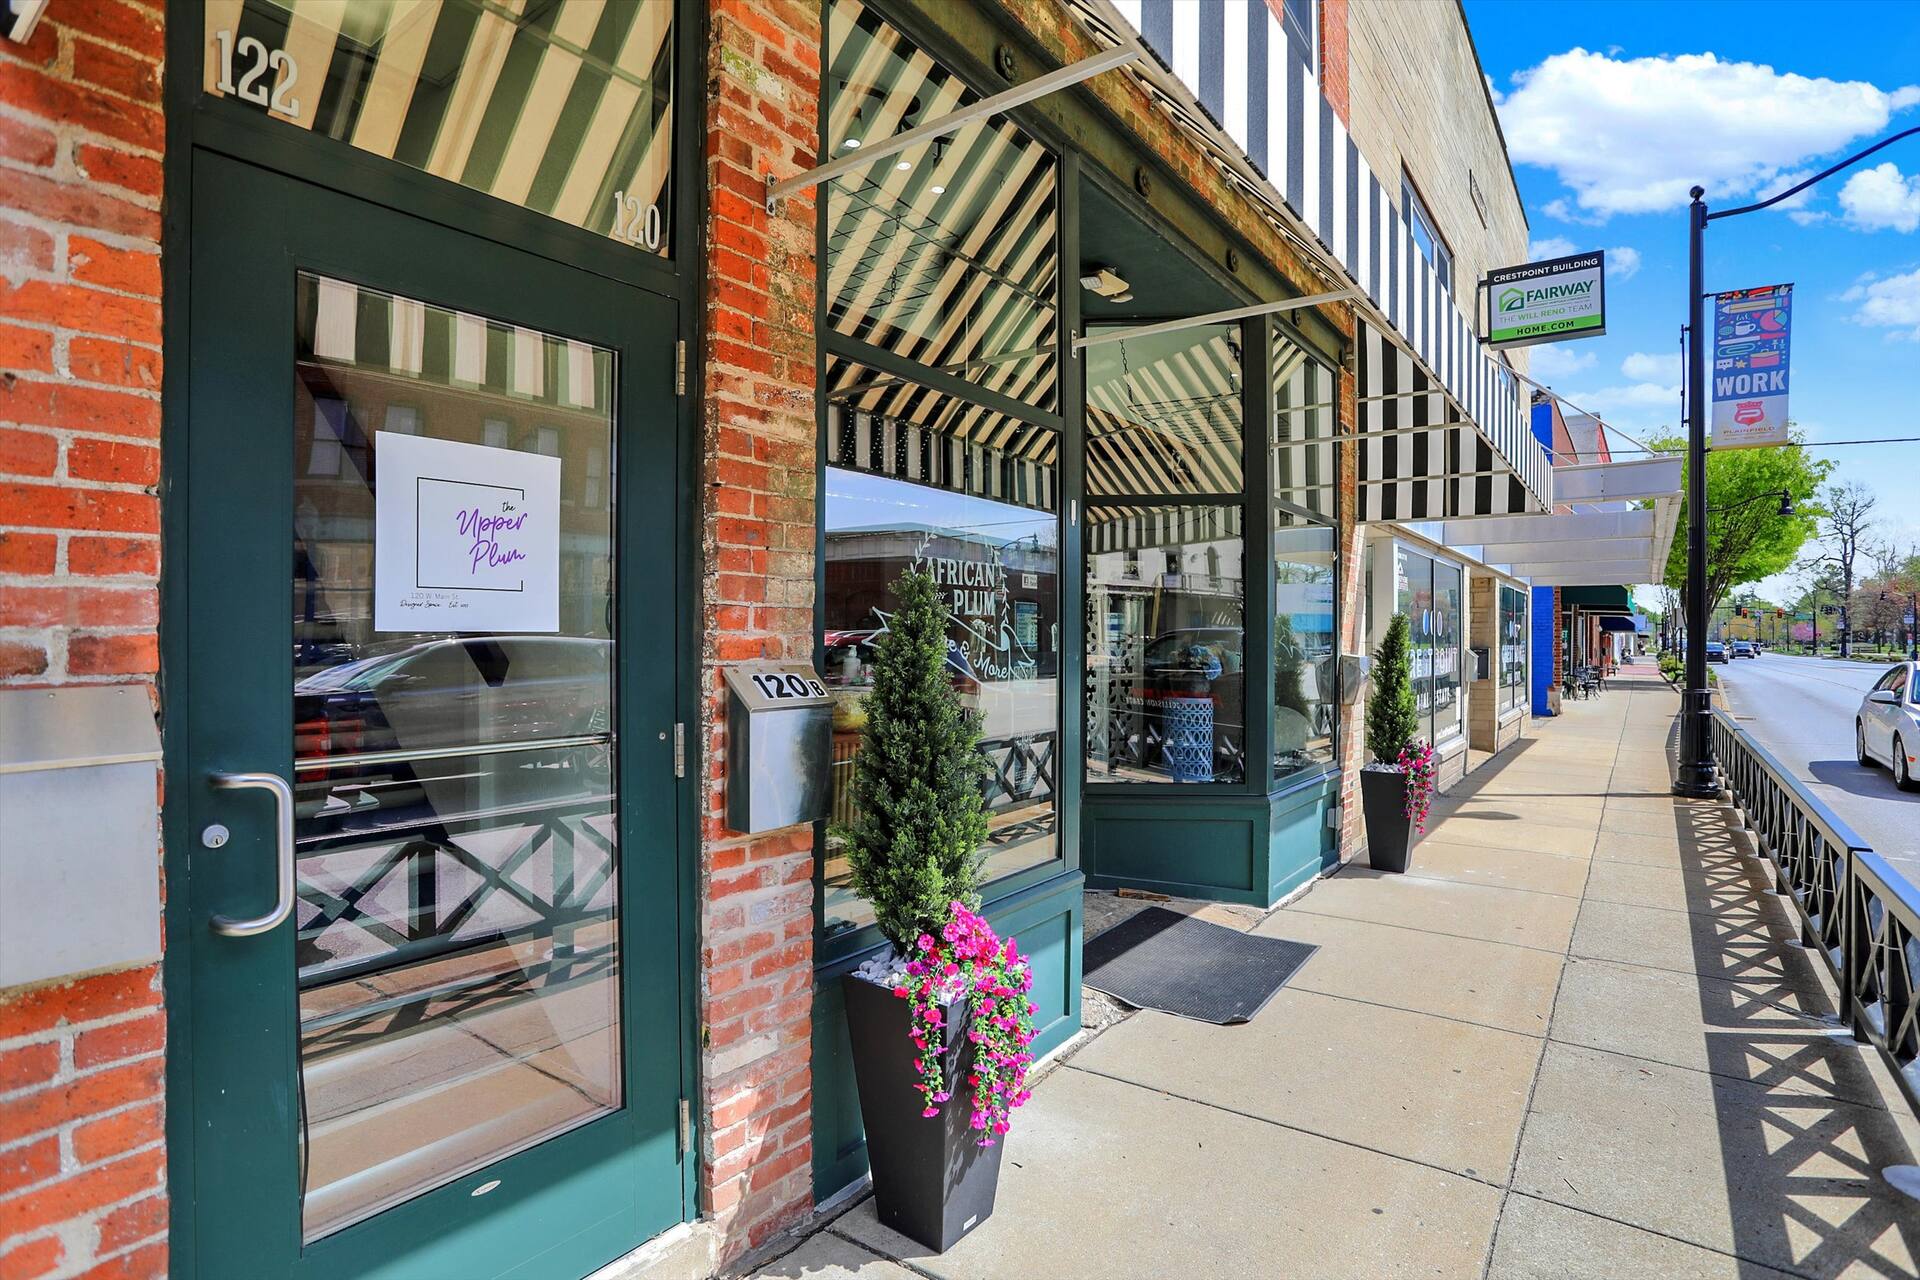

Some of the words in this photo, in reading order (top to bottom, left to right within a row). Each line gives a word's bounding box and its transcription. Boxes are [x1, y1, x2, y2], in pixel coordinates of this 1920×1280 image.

[216, 30, 299, 118] 122
[614, 190, 660, 250] 120
[1493, 266, 1551, 283] CRESTPOINT
[1552, 258, 1598, 272] BUILDING
[1526, 279, 1594, 302] FAIRWAY
[1499, 314, 1517, 324] THE
[1518, 311, 1538, 321] WILL
[1541, 308, 1565, 317] RENO
[1568, 303, 1592, 313] TEAM
[1517, 321, 1574, 335] HOME.COM
[1716, 369, 1786, 397] WORK
[502, 501, 516, 512] the
[456, 508, 527, 542] Upper
[469, 540, 526, 574] Plum
[925, 556, 995, 588] AFRICAN
[953, 588, 996, 616] PLUM
[974, 651, 1009, 679] More
[752, 674, 810, 699] 120
[809, 681, 825, 696] B
